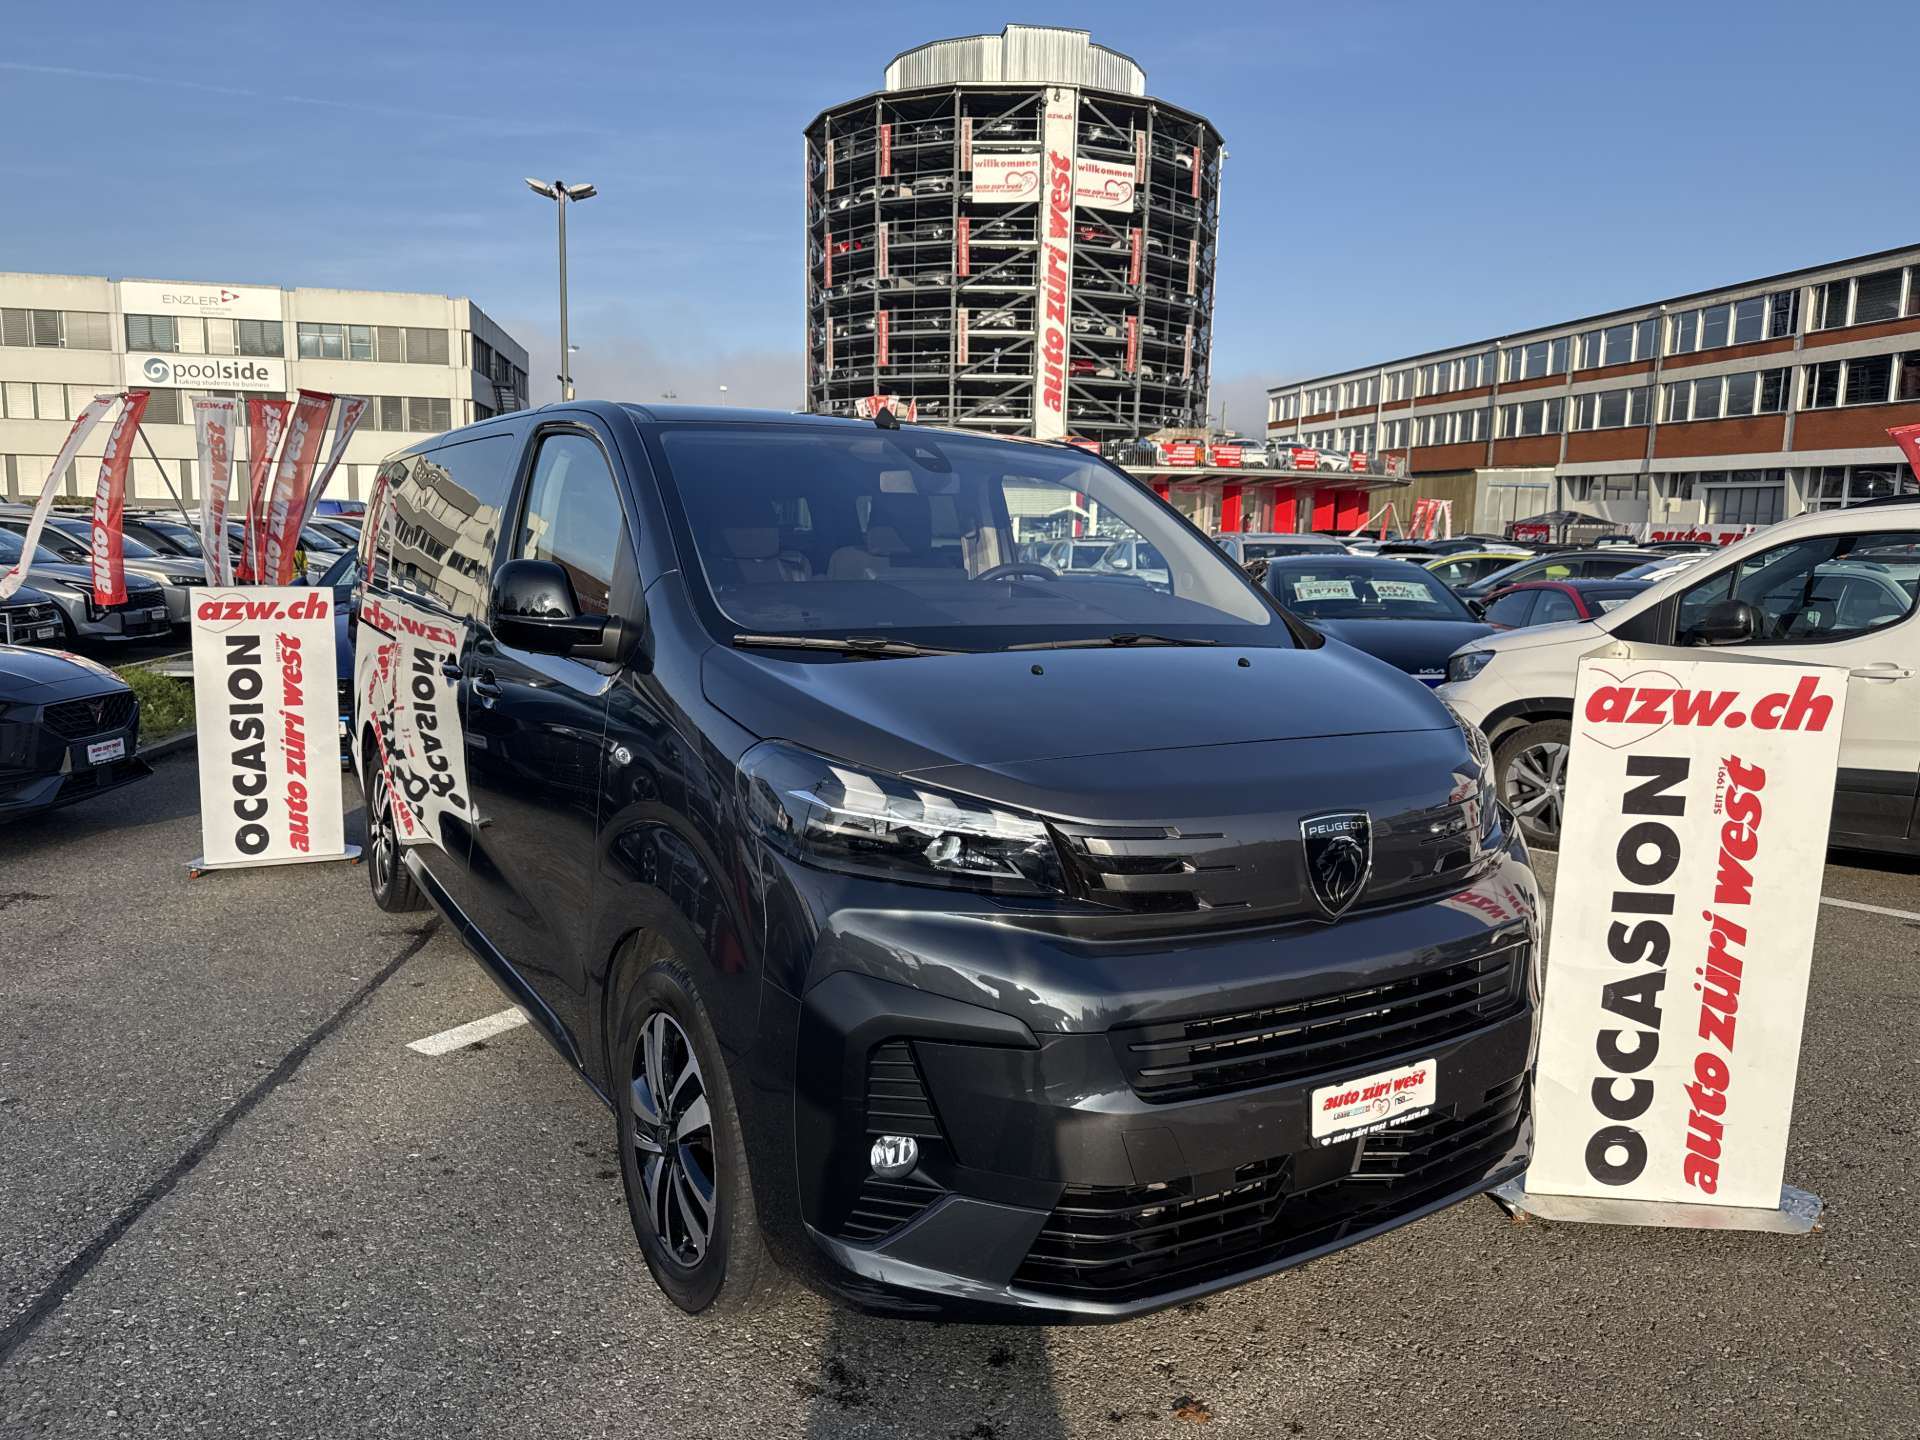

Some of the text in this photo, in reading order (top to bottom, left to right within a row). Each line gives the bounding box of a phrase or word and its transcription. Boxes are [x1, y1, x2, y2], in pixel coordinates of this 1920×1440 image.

[974, 159, 1038, 168] willkommen
[1077, 163, 1134, 178] willkommen
[162, 294, 219, 306] ENZLER
[1041, 150, 1071, 413] auto züri west
[173, 360, 269, 384] poolside
[233, 380, 240, 388] to
[93, 527, 113, 595] auto
[264, 539, 282, 586] uto
[197, 592, 329, 622] azw.ch
[1584, 676, 1834, 732] azw.ch
[225, 635, 270, 856] OCCASION
[276, 632, 310, 853] auto züri west
[1713, 766, 1727, 815] SEIT 1991
[1308, 821, 1365, 836] PEUGEOT
[1584, 755, 1691, 1187] OCCASION
[1683, 754, 1767, 1196] auto züri west
[1323, 1090, 1360, 1111] auto
[1360, 1078, 1393, 1102] züri
[1393, 1071, 1427, 1092] west
[1332, 1132, 1351, 1144] auto
[1351, 1126, 1369, 1139] züri
[1369, 1121, 1387, 1133] west
